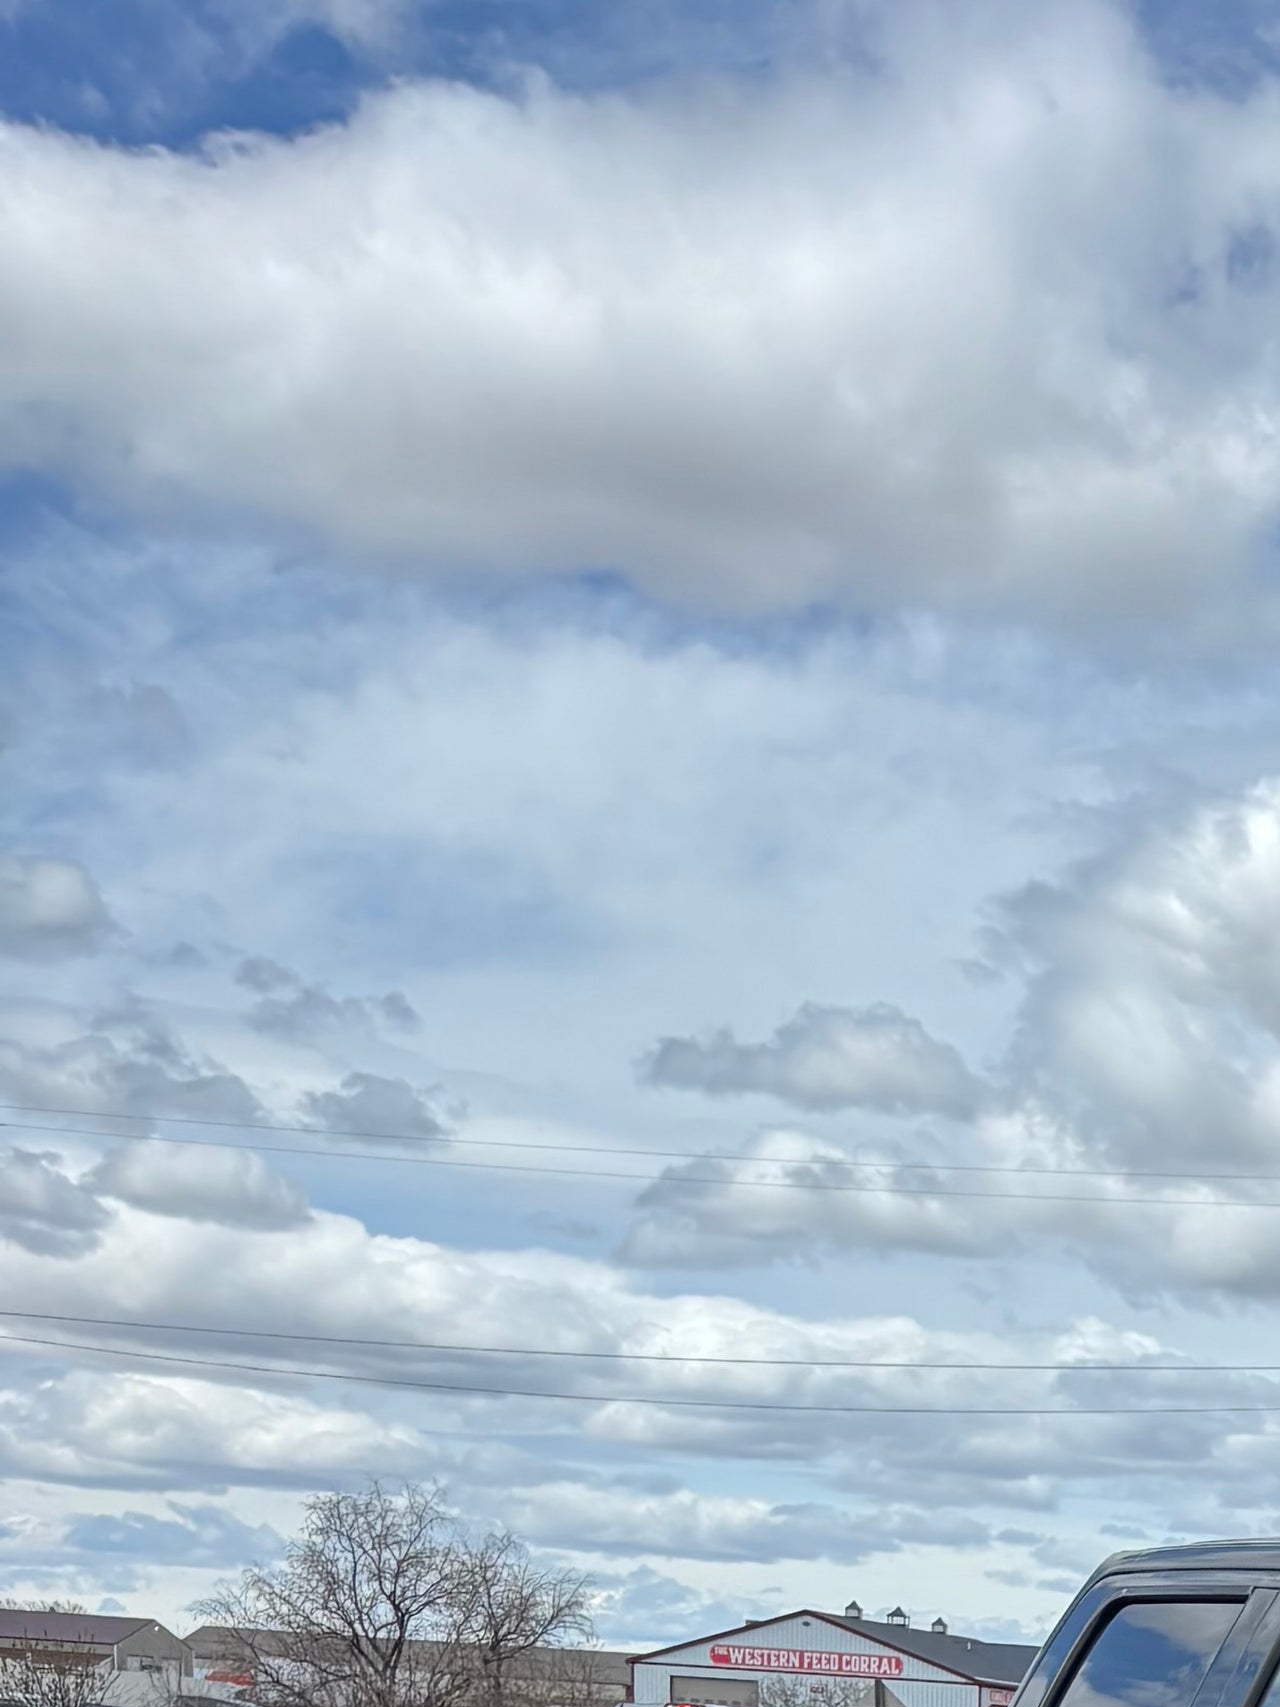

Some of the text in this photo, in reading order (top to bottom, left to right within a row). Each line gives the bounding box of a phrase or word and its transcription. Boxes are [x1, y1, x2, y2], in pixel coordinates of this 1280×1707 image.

[729, 1647, 800, 1668] WESTERN
[803, 1653, 838, 1671] FEED
[842, 1655, 900, 1674] CORRAL
